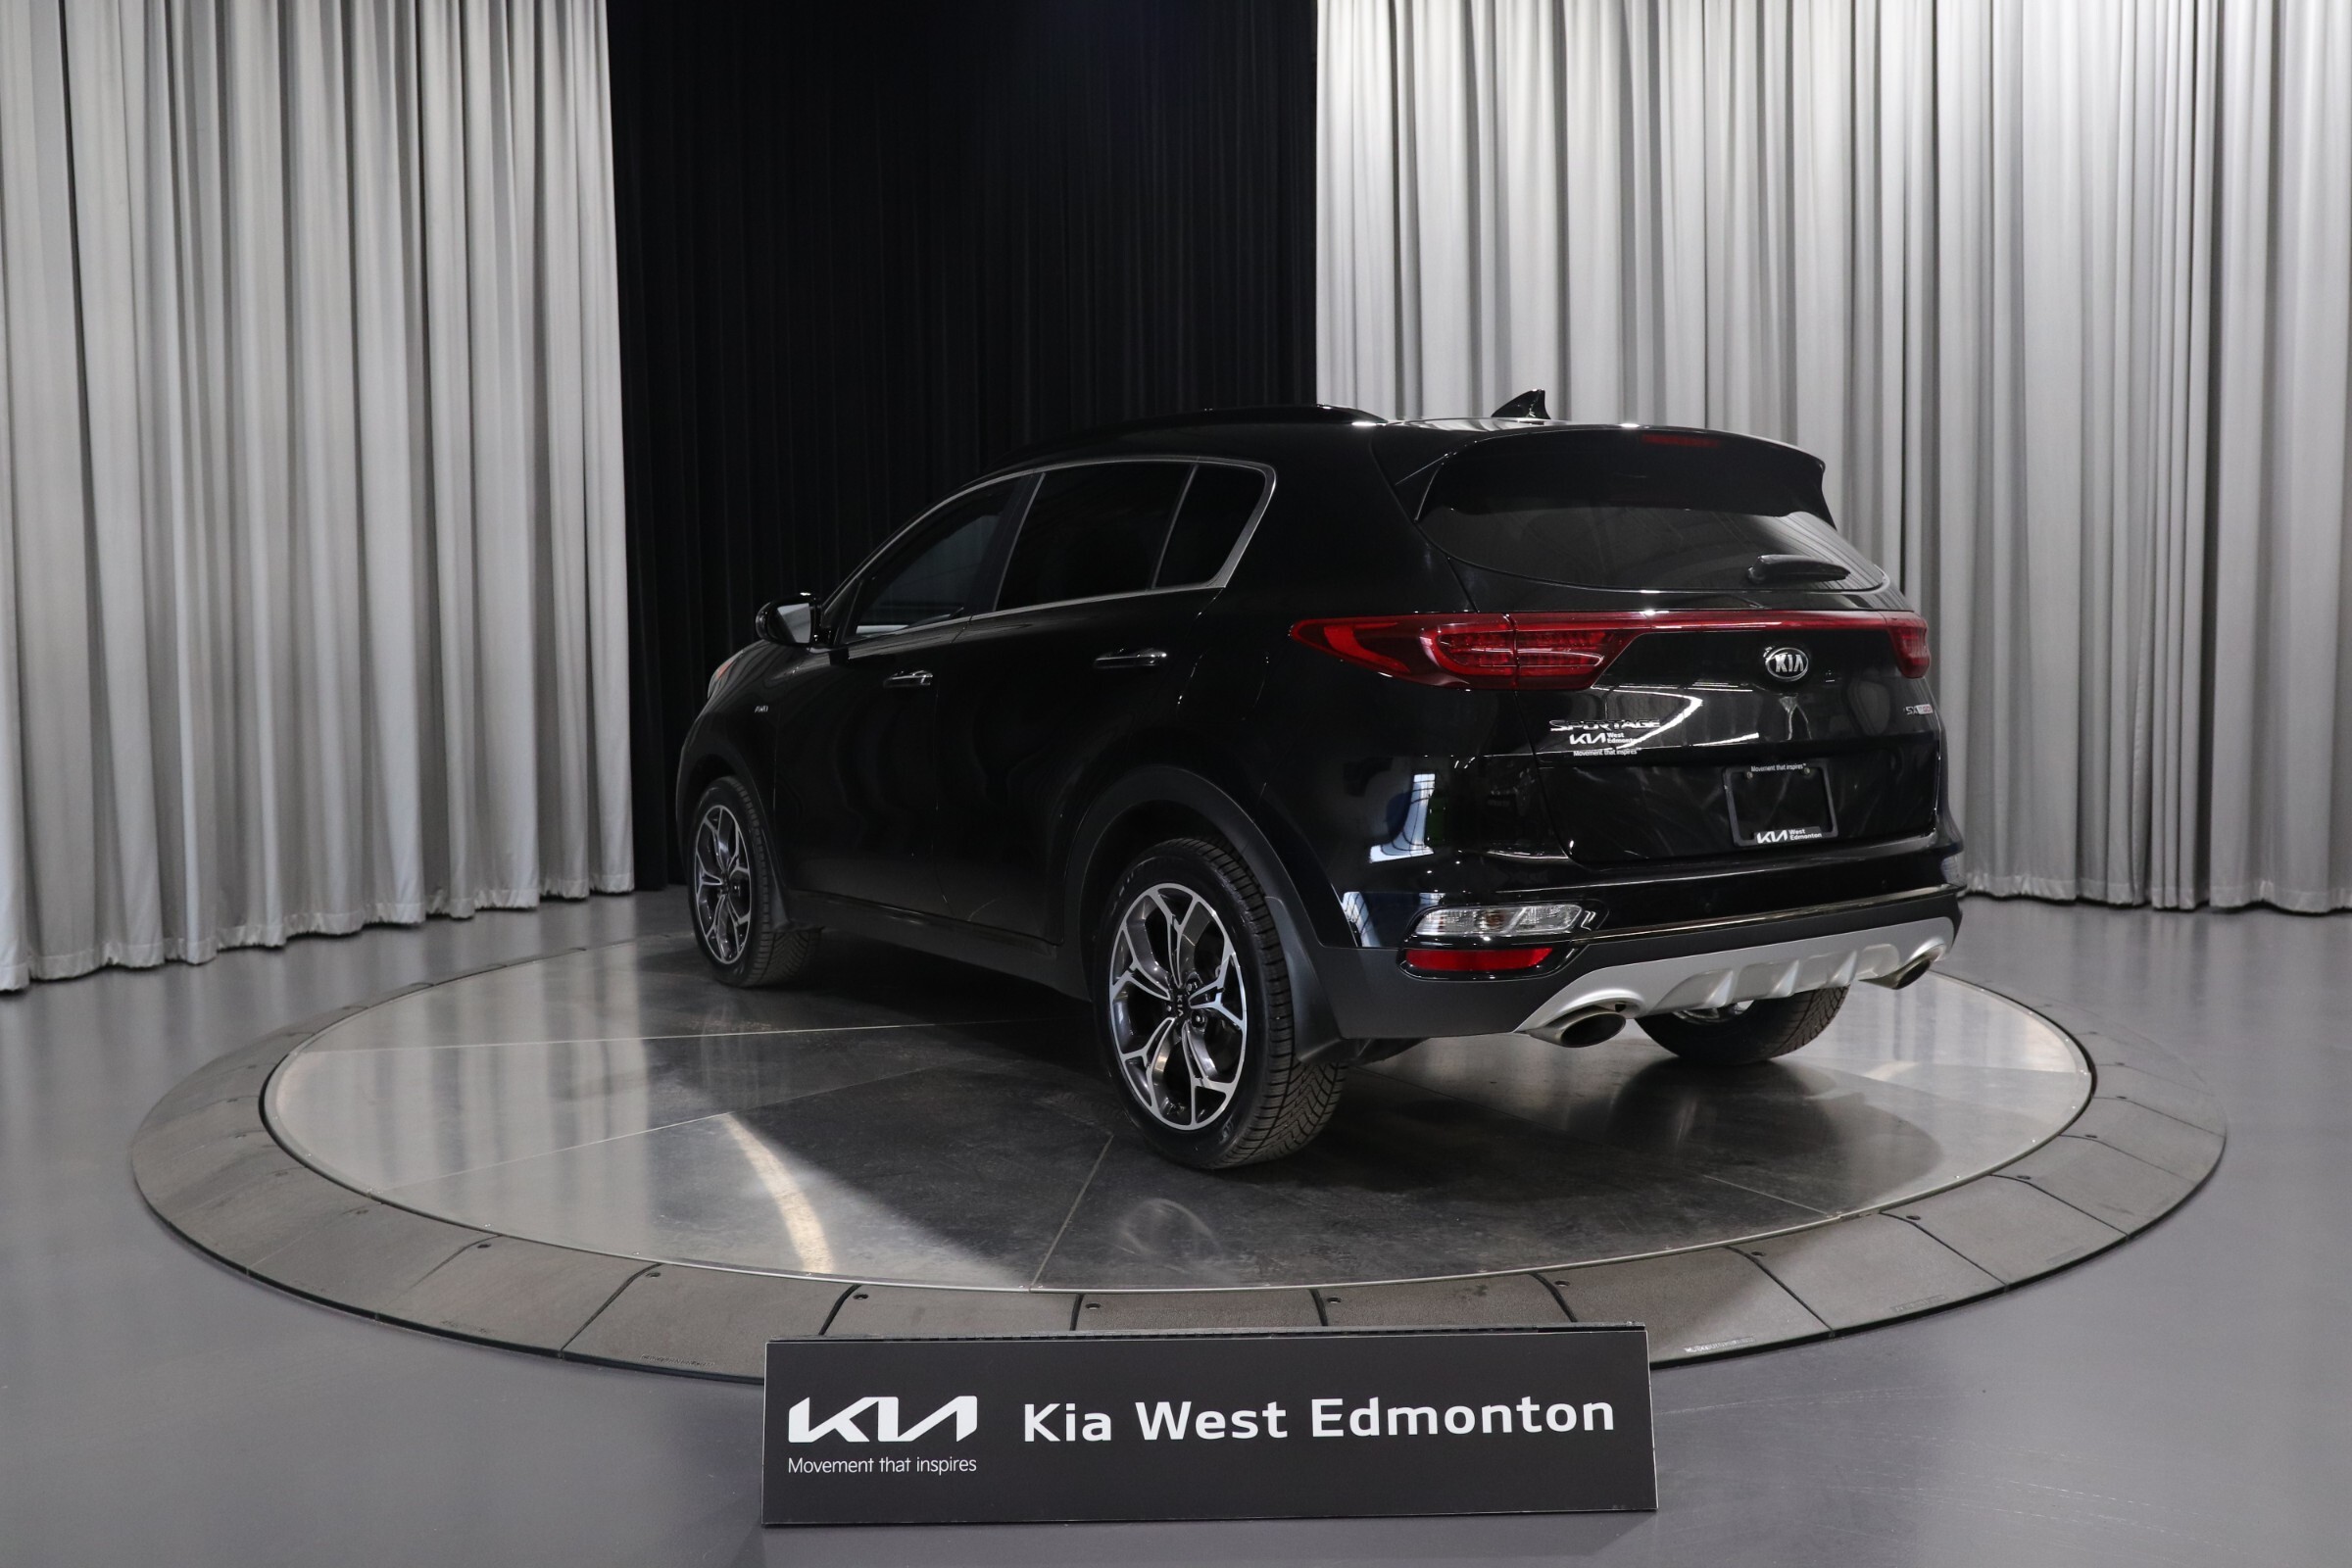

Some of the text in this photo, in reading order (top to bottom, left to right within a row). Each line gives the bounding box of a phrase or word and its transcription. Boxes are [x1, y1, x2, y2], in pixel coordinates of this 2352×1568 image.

[1775, 654, 1804, 673] KIA
[1548, 719, 1660, 731] SPORTAGE
[1569, 732, 1606, 745] KIA
[1756, 830, 1788, 843] KIA
[788, 1396, 978, 1444] KIA
[1024, 1396, 1614, 1443] Kia West Edmonton
[788, 1456, 977, 1476] Movement that inspires
